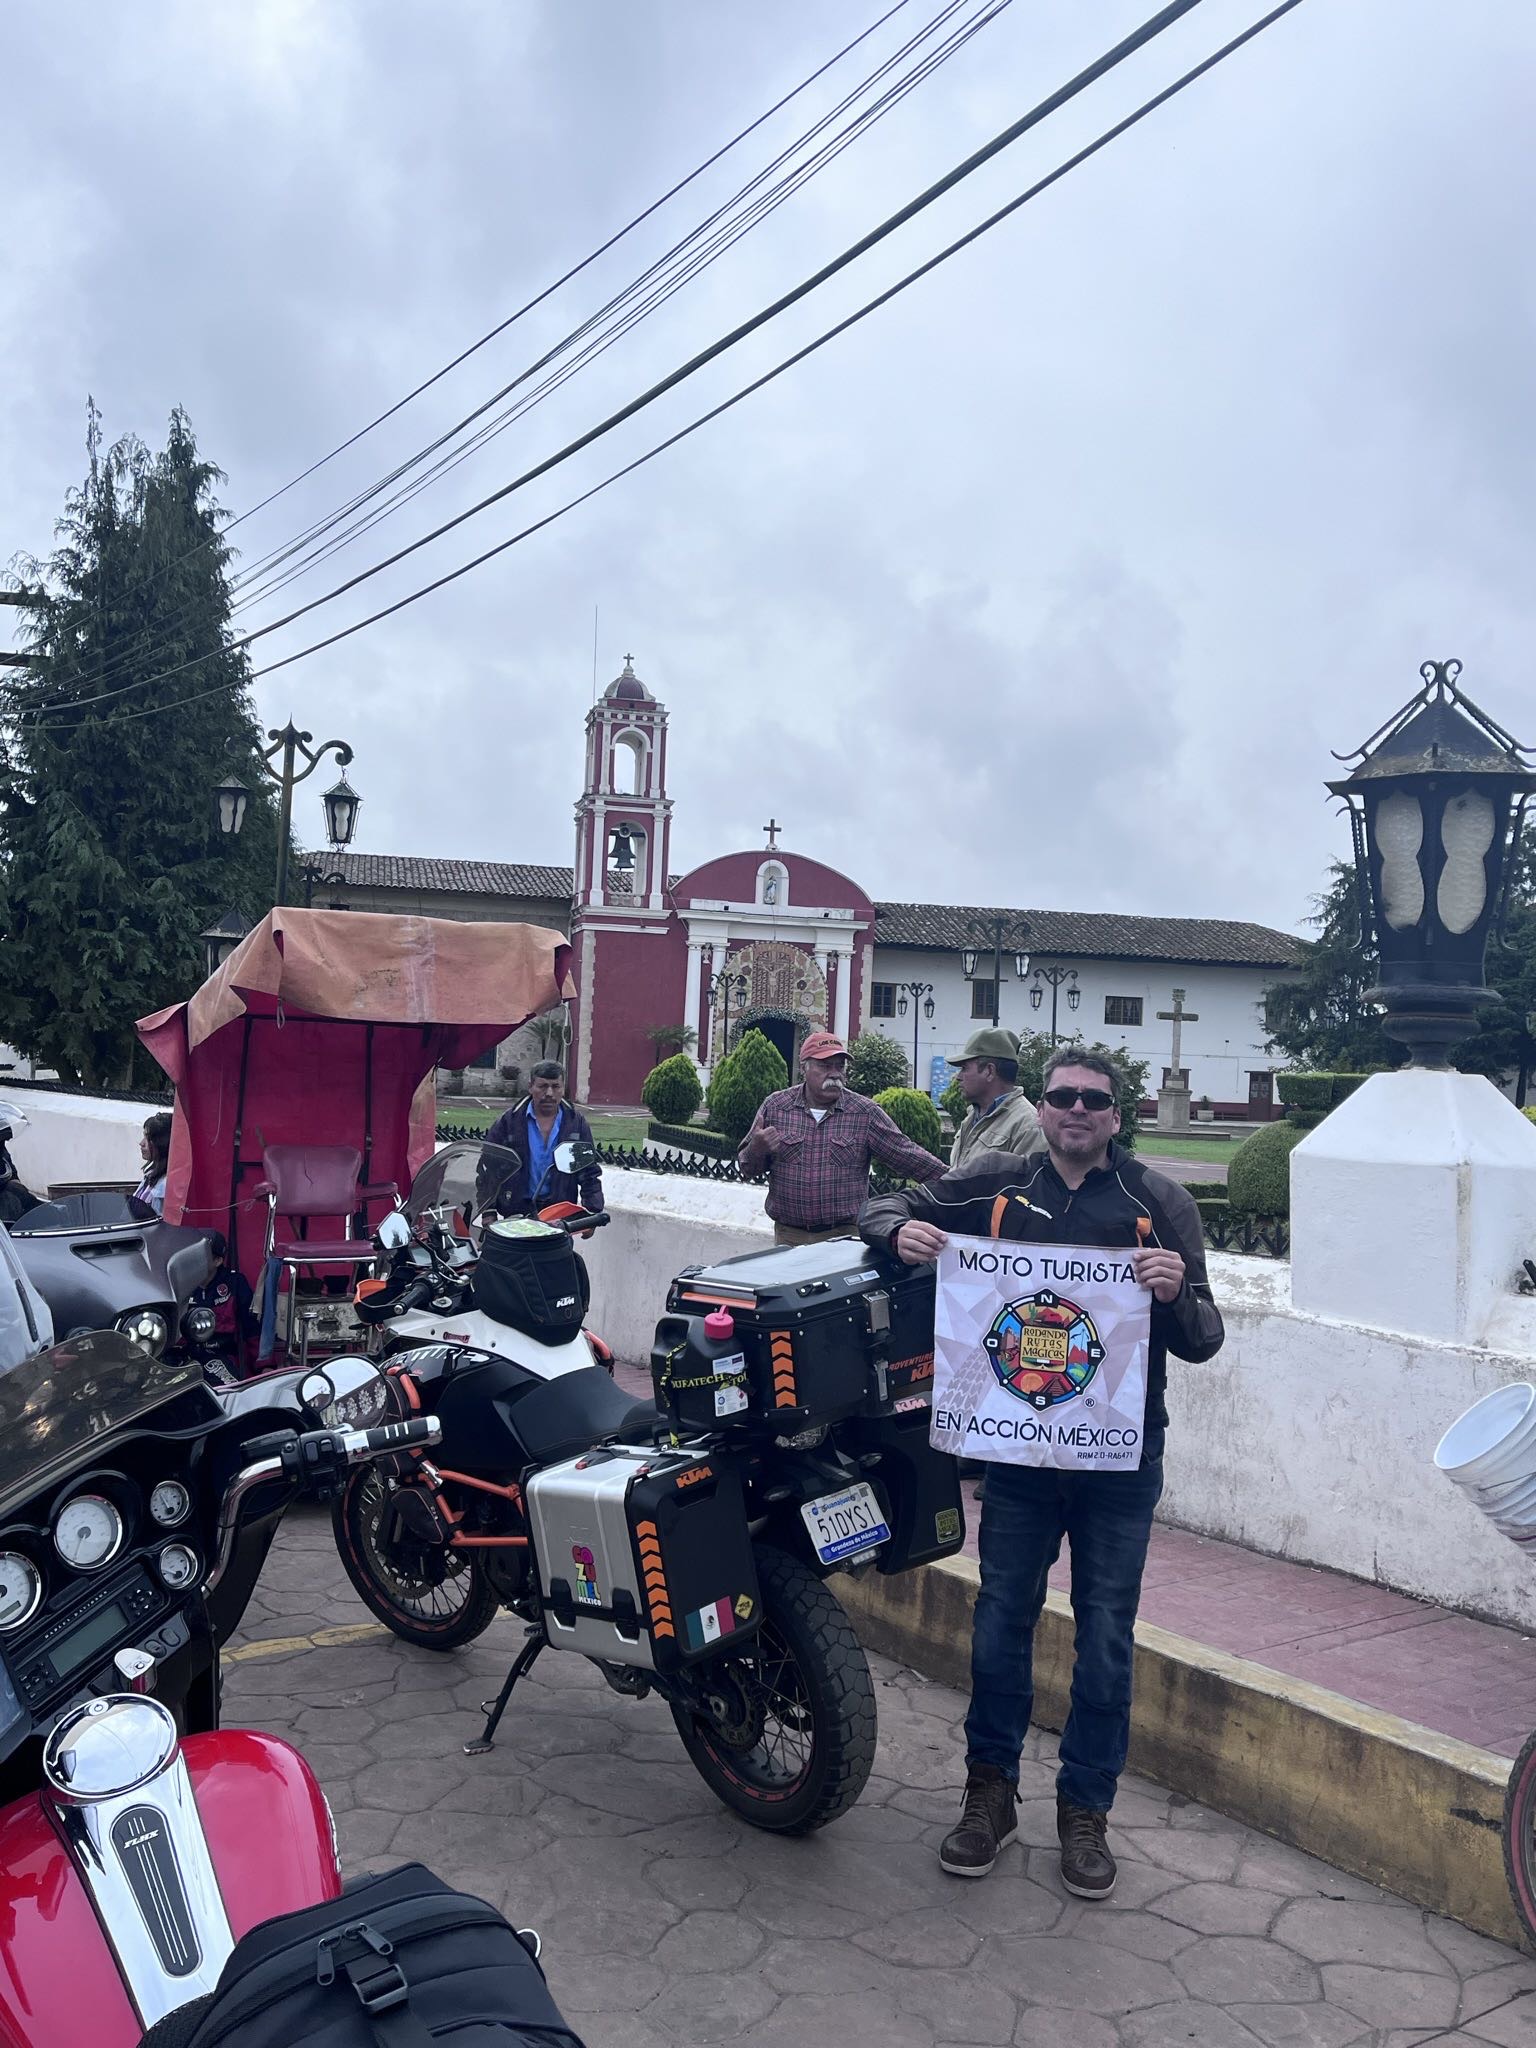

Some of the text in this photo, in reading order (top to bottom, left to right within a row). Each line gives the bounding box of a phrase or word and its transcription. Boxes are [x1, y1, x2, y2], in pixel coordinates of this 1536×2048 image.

[959, 1250, 1136, 1283] MOTO TURISTA
[556, 1296, 575, 1308] KTM
[1040, 1294, 1053, 1304] N
[986, 1338, 998, 1348] O
[1091, 1348, 1101, 1358] E
[895, 1398, 928, 1413] KTM
[1035, 1396, 1046, 1406] S
[935, 1410, 1139, 1447] EN ACCIÓN MÉXICO
[676, 1466, 713, 1489] KTM
[817, 1501, 877, 1544] 51DYS1
